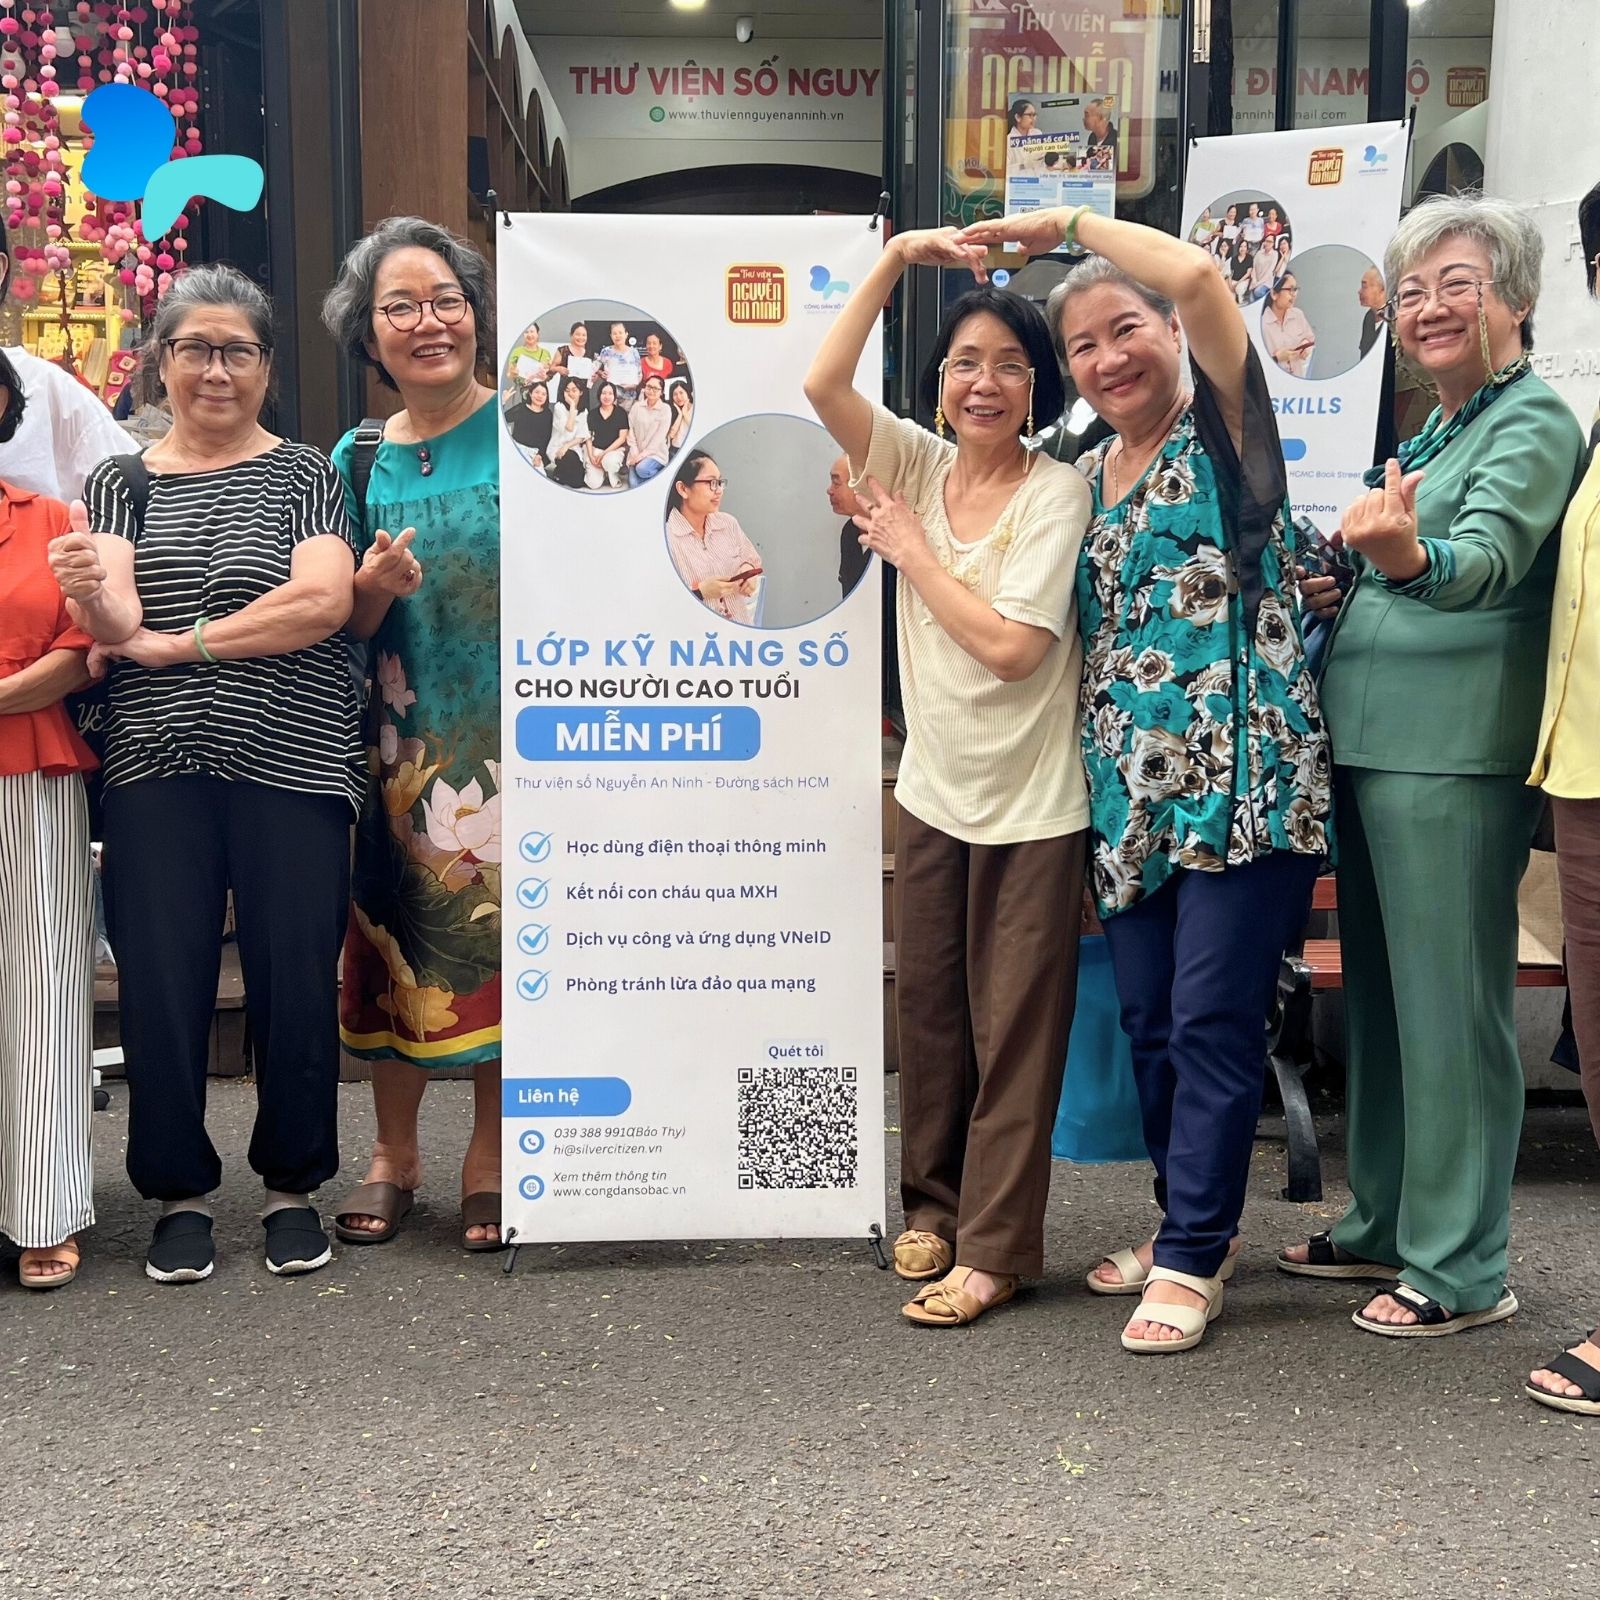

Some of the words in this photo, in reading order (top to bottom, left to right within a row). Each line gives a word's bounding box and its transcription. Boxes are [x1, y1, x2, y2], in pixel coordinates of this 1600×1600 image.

[1011, 3, 1055, 33] THƯ
[1061, 8, 1106, 38] VIỆN
[569, 62, 639, 97] THƯ
[647, 59, 724, 103] VIỆN
[733, 55, 780, 97] SỐ
[788, 66, 883, 97] NGUY
[1297, 67, 1368, 96] NAM
[668, 108, 845, 123] www.thuviennguyenanninh.vn
[732, 279, 782, 301] NGUYỄN
[732, 302, 749, 319] AN
[751, 302, 781, 319] NINH
[1271, 396, 1342, 415] SKILLS
[1289, 470, 1314, 479] HCMC
[1316, 470, 1335, 479] Book
[1337, 470, 1361, 479] Street
[1290, 503, 1337, 514] artphone
[517, 631, 589, 666] LỚP
[605, 633, 655, 666] KỸ
[670, 632, 783, 666] NĂNG
[799, 631, 848, 666] SỐ
[515, 679, 573, 698] CHO
[581, 674, 668, 698] NGƯỜI
[676, 680, 733, 698] CAO
[740, 671, 799, 698] TUỔI
[557, 710, 649, 751] MIỄN
[662, 713, 721, 751] PHÍ
[515, 777, 542, 789] Thư
[545, 777, 572, 790] viện
[577, 774, 591, 788] số
[597, 774, 646, 791] Nguyễn
[651, 777, 667, 788] An
[673, 777, 702, 788] Ninh
[715, 776, 759, 791] Đường
[764, 777, 793, 789] sách
[798, 776, 828, 788] HCM
[568, 841, 599, 856] Học
[604, 840, 644, 856] dùng
[649, 840, 683, 856] điện
[688, 839, 729, 856] thoại
[734, 839, 781, 856] thông
[786, 839, 825, 852] minh
[567, 882, 593, 899] Kết
[599, 882, 623, 899] nối
[628, 889, 657, 899] con
[662, 885, 700, 898] cháu
[706, 889, 735, 902] qua
[741, 885, 777, 898] MXH
[567, 932, 602, 948] Dịch
[608, 935, 627, 948] vụ
[633, 932, 671, 948] công
[676, 931, 694, 944] và
[699, 931, 731, 947] ứng
[735, 931, 776, 947] dụng
[780, 931, 831, 943] VNeID
[567, 978, 617, 994] Phòng
[622, 977, 665, 990] tránh
[671, 977, 697, 990] lừa
[702, 976, 732, 990] đảo
[737, 980, 766, 992] qua
[772, 978, 816, 992] mạng
[769, 1046, 802, 1059] Quét
[805, 1045, 823, 1056] tôi
[519, 1089, 553, 1103] Liên
[559, 1088, 579, 1106] hệ
[554, 1128, 577, 1138] 039
[580, 1128, 601, 1138] 388
[554, 1144, 662, 1156] hi@silvercitizen.vn
[553, 1172, 578, 1182] Xem
[582, 1171, 611, 1181] thêm
[615, 1171, 648, 1183] thông
[652, 1172, 666, 1180] tin
[553, 1185, 685, 1198] www.congdansobac.vn
